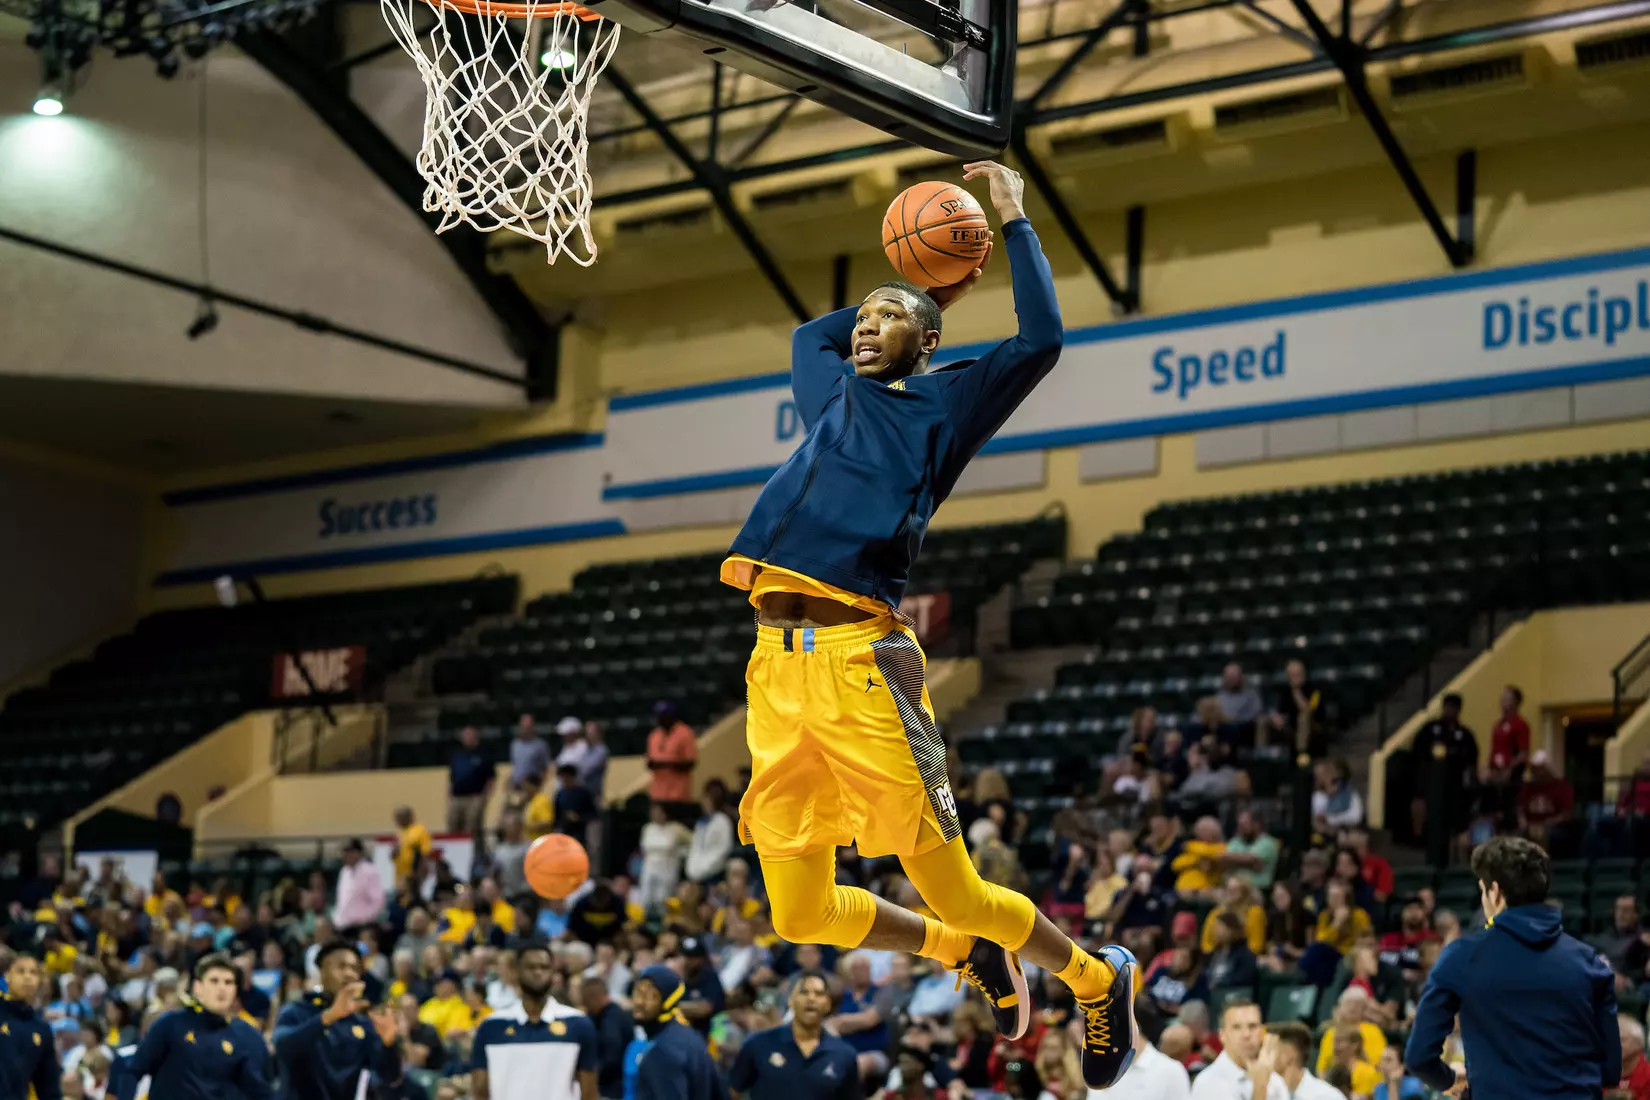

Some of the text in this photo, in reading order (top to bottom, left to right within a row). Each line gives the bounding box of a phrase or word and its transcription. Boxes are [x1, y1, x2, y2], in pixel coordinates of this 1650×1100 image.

[1483, 279, 1650, 351] Discipl
[1152, 330, 1286, 400] Speed
[318, 494, 438, 538] Success
